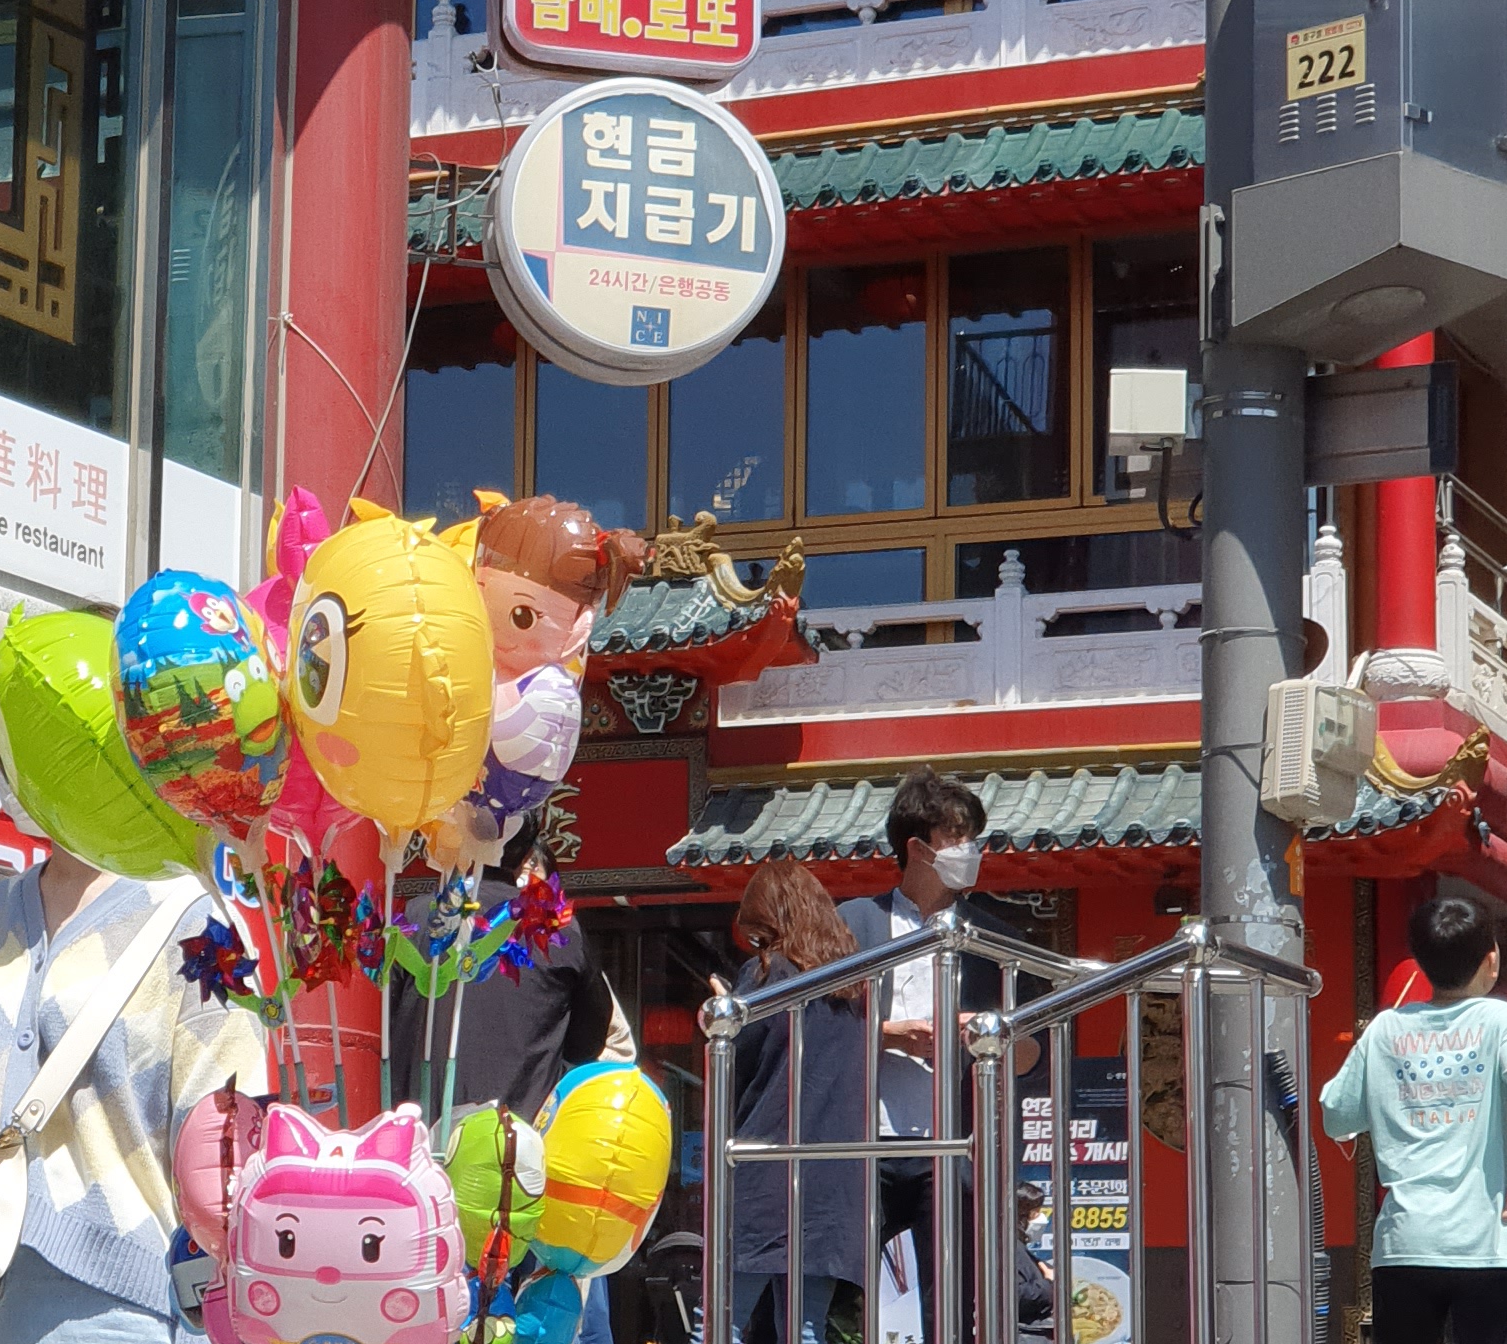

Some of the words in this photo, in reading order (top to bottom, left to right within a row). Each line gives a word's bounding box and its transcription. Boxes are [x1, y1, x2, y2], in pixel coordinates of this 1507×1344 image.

[1298, 44, 1356, 90] 222
[581, 111, 699, 178] 현금
[576, 178, 758, 253] 지급기
[589, 268, 731, 302] 24시간/은행공동
[14, 522, 106, 571] restaurant
[1409, 1109, 1476, 1128] ITALIA
